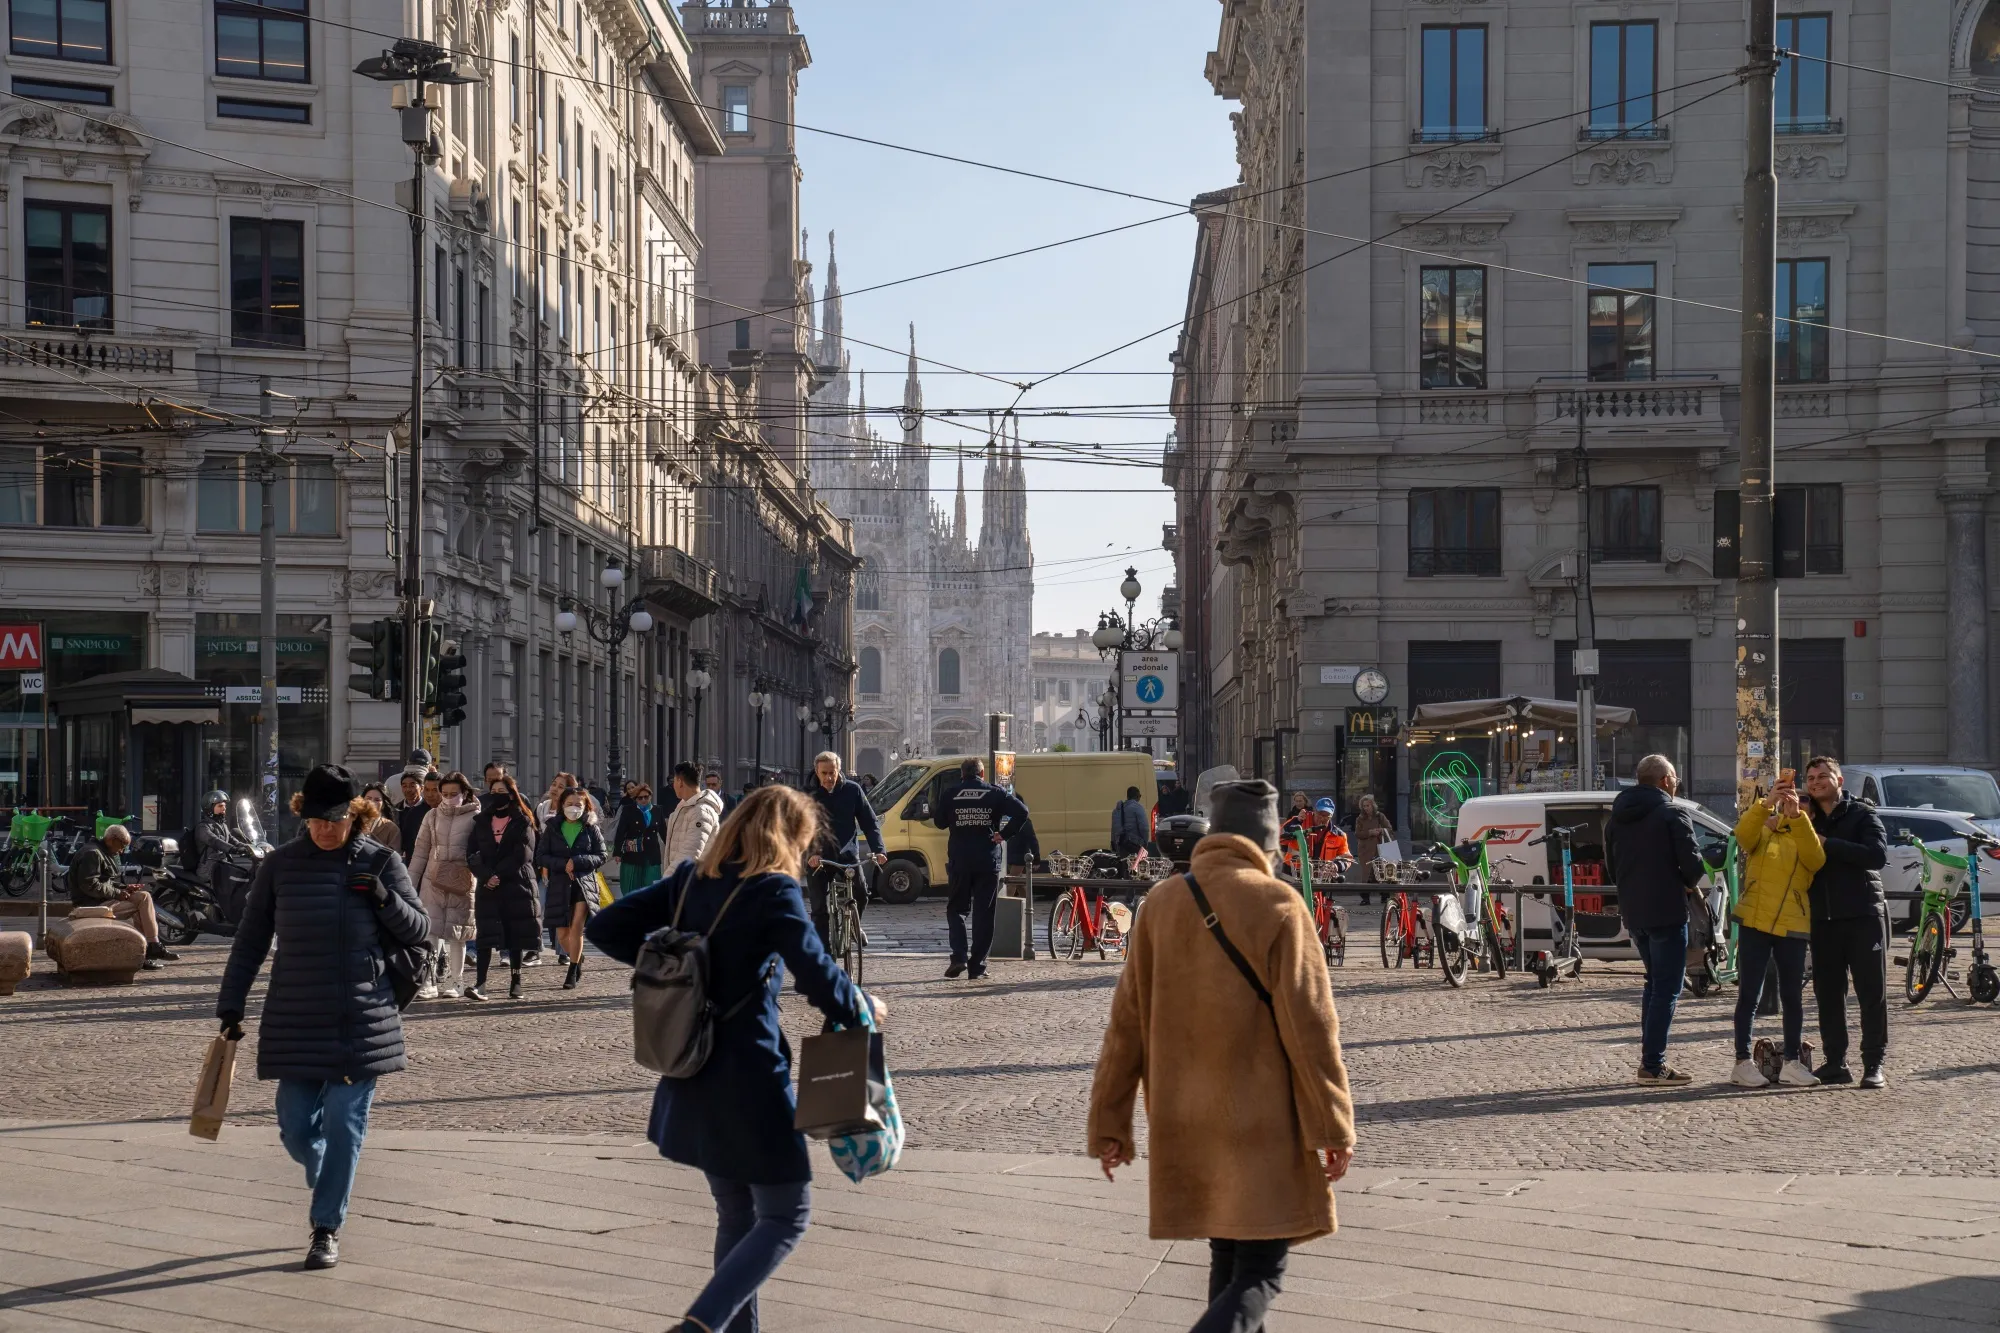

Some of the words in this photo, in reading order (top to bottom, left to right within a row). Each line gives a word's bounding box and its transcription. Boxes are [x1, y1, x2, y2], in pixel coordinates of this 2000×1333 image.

[66, 639, 120, 650] SANPAOLO
[207, 641, 242, 652] INTESA
[1132, 664, 1169, 672] pedonale
[22, 678, 42, 689] WC
